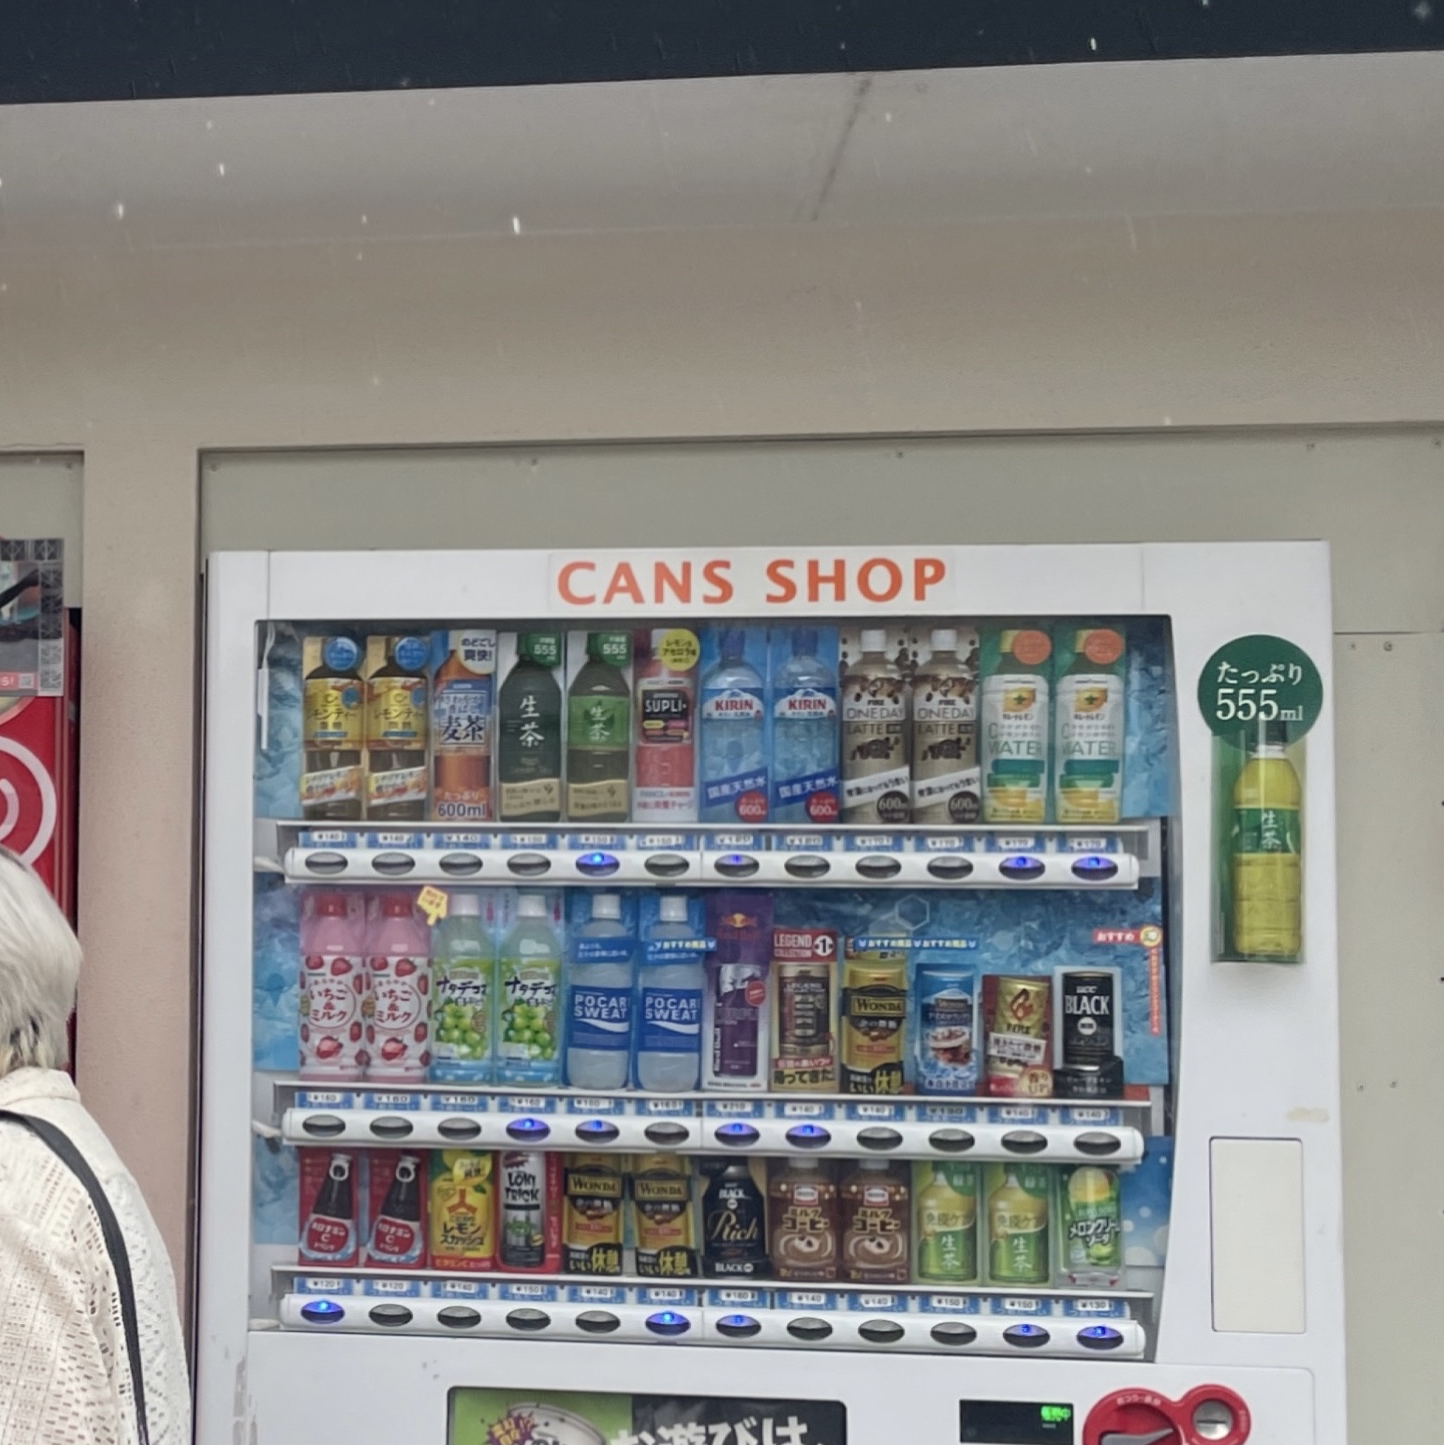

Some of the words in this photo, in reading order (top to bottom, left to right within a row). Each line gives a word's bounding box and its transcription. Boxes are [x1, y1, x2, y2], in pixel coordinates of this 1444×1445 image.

[556, 560, 734, 606] CANS
[764, 556, 947, 604] SHOP
[461, 637, 496, 649] のどごし
[1216, 660, 1304, 686] たっぷり
[714, 699, 754, 712] KIRIN
[787, 699, 827, 711] KIRIN
[1215, 688, 1304, 722] 555ml
[442, 716, 485, 742] 麦茶
[519, 695, 546, 748] 生茶
[588, 705, 611, 742] 生茶
[437, 802, 487, 818] 600ml
[1261, 810, 1283, 850] 生茶
[773, 933, 812, 948] LEGEND
[818, 938, 830, 954] 1
[309, 988, 349, 1002] いちご
[374, 988, 412, 1002] いちご
[855, 998, 903, 1013] WONDA
[1064, 995, 1110, 1015] BLACK
[309, 1010, 349, 1023] ミルク
[374, 1011, 412, 1024] ミルク
[573, 1006, 627, 1020] SWEAT
[644, 1008, 697, 1022] SWEAT
[571, 1175, 617, 1194] WONDA
[639, 1180, 683, 1196] WONDA
[504, 1186, 540, 1204] TRICK
[718, 1188, 746, 1200] BLACK
[442, 1222, 484, 1236] レモン
[708, 1211, 759, 1241] Rich
[320, 1233, 330, 1243] C
[385, 1234, 395, 1244] C
[941, 1234, 960, 1270] 生茶
[1013, 1235, 1032, 1272] 生茶
[715, 1262, 744, 1273] BLACK
